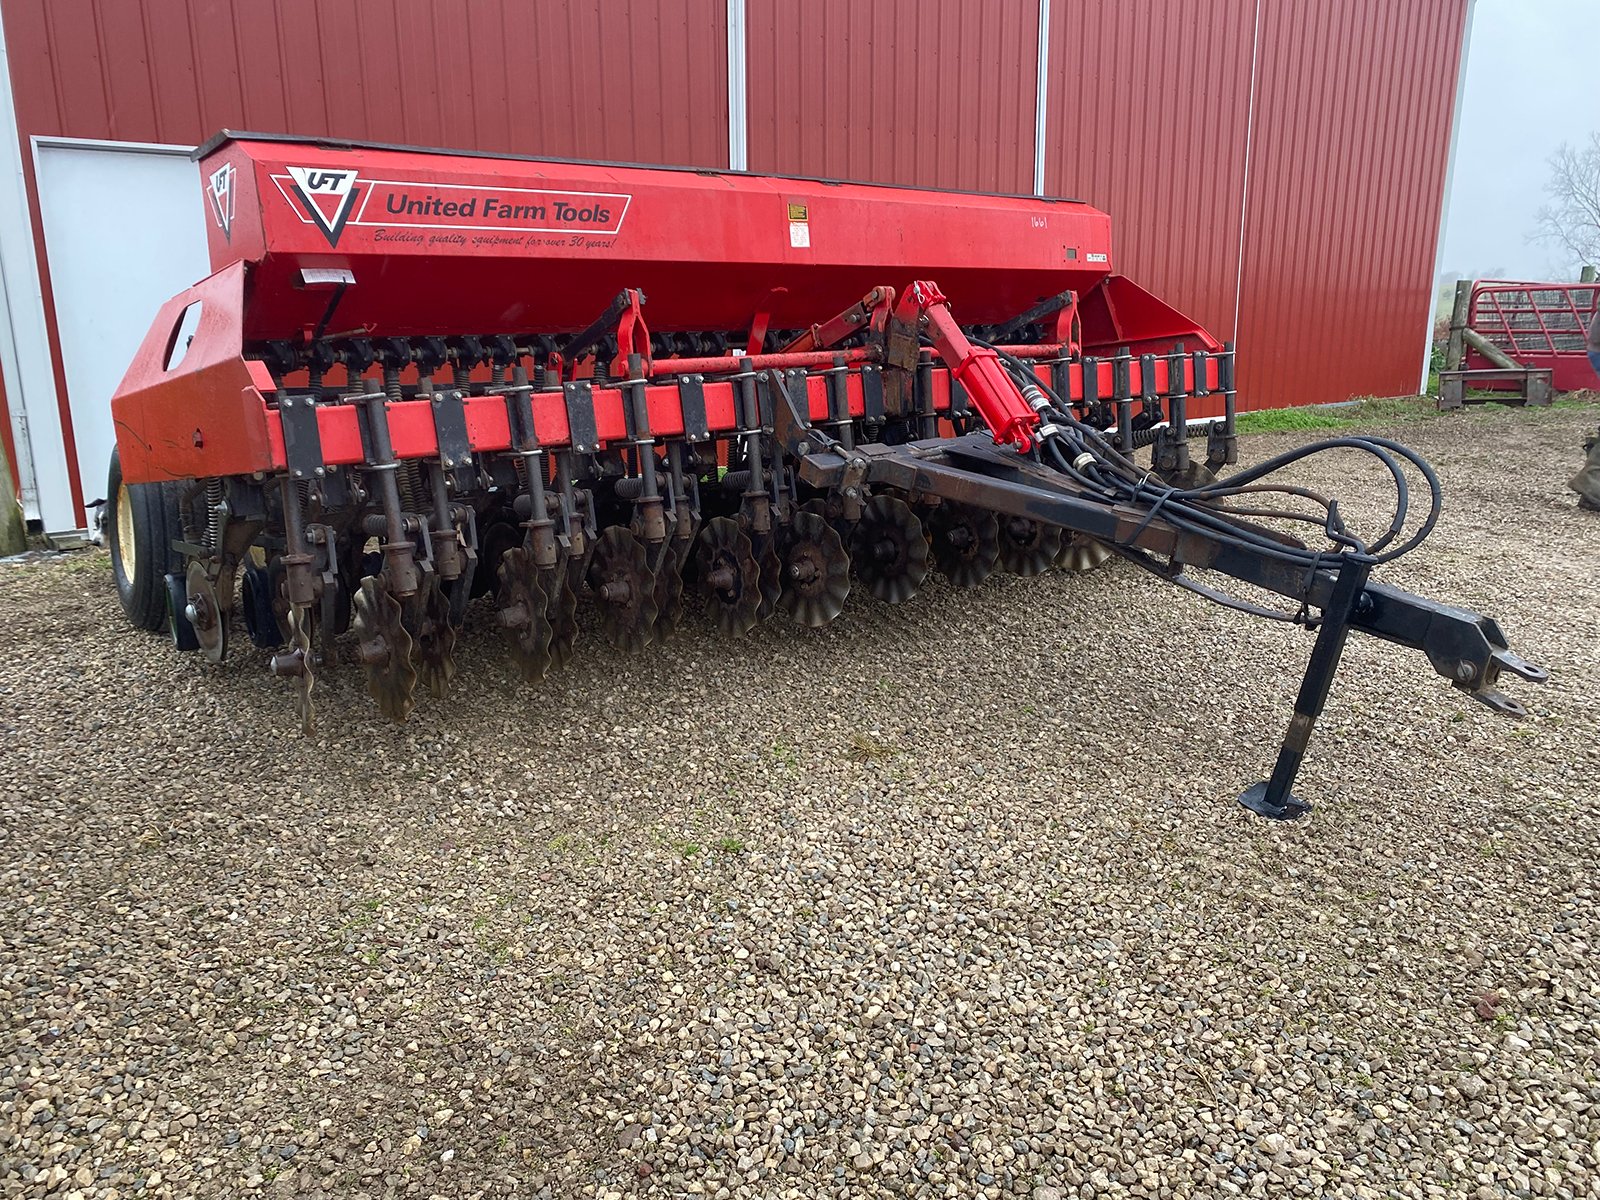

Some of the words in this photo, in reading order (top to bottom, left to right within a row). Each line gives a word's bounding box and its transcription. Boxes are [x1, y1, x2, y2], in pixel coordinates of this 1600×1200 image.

[307, 172, 347, 190] UFT
[386, 193, 477, 217] United
[482, 198, 546, 220] Farm
[553, 202, 611, 223] Tools
[1031, 216, 1048, 228] 1661
[374, 229, 424, 246] Building
[428, 233, 467, 247] quality
[525, 236, 542, 249] for
[545, 239, 565, 247] over
[568, 236, 584, 247] 30
[585, 237, 617, 250] years!
